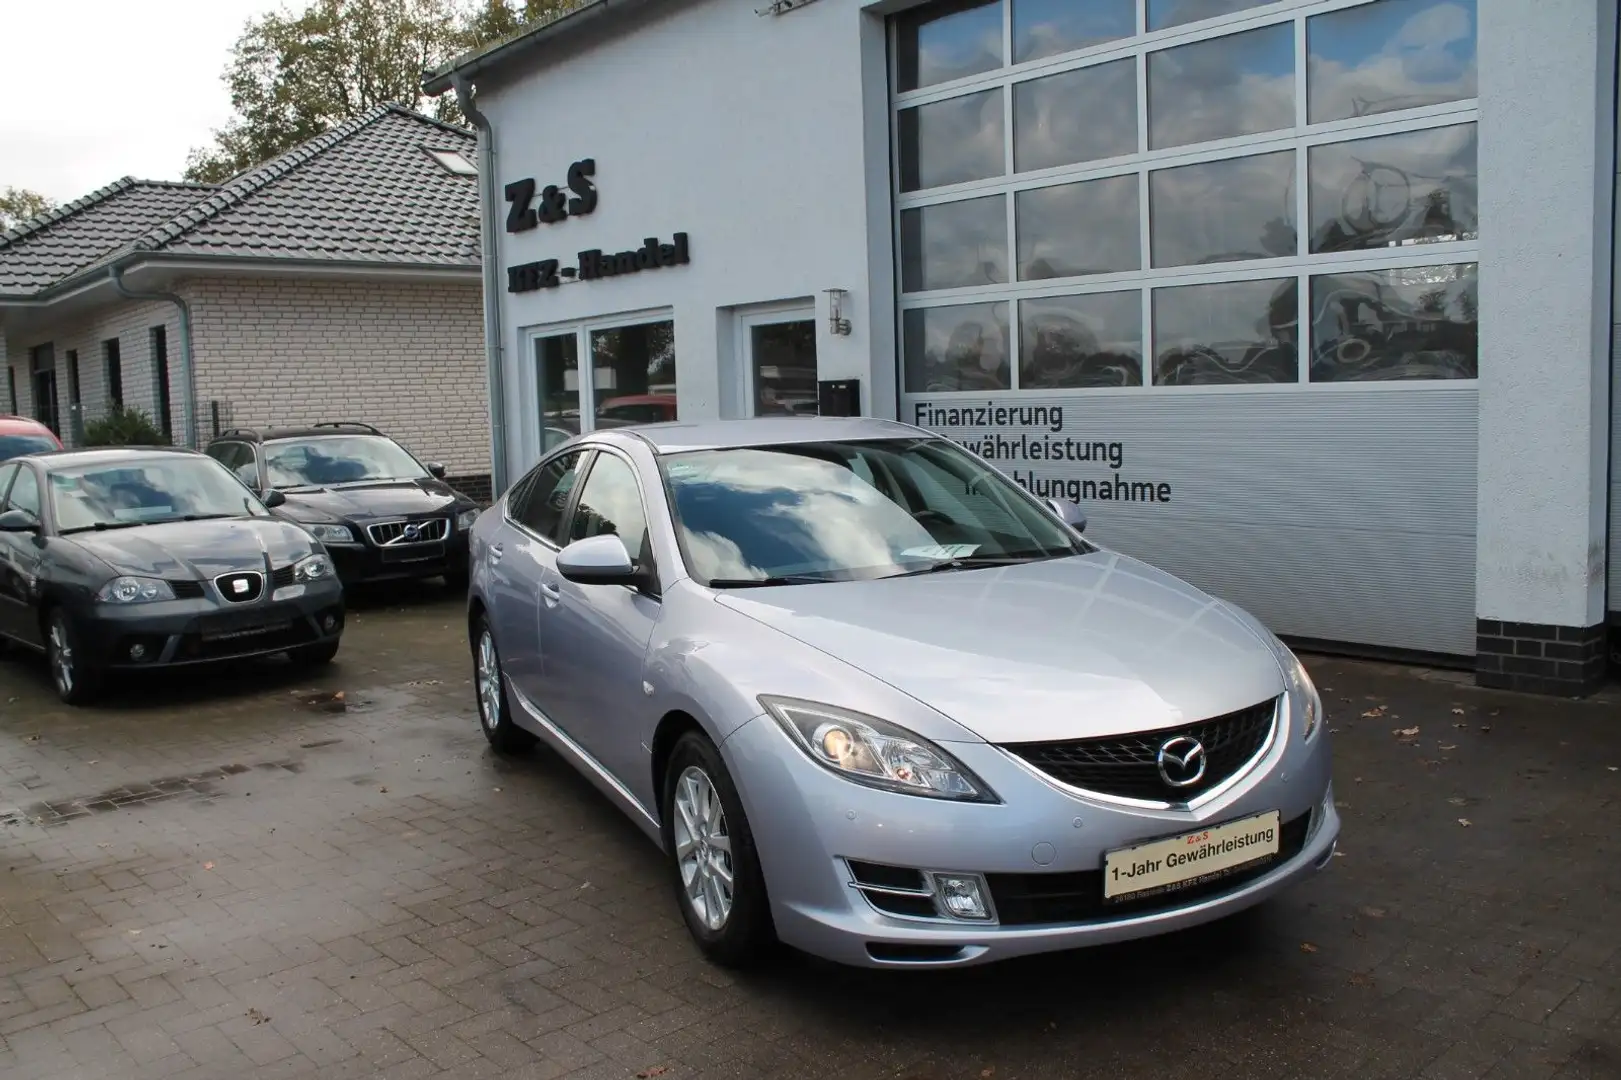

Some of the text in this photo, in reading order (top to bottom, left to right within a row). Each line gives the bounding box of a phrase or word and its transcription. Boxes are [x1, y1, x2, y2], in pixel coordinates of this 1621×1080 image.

[505, 158, 598, 232] Z&S
[915, 402, 1063, 432] Finanzierung
[939, 434, 1123, 468] währleistung
[1112, 860, 1162, 881] 1-Jahr
[1166, 828, 1274, 867] Gewährleistung
